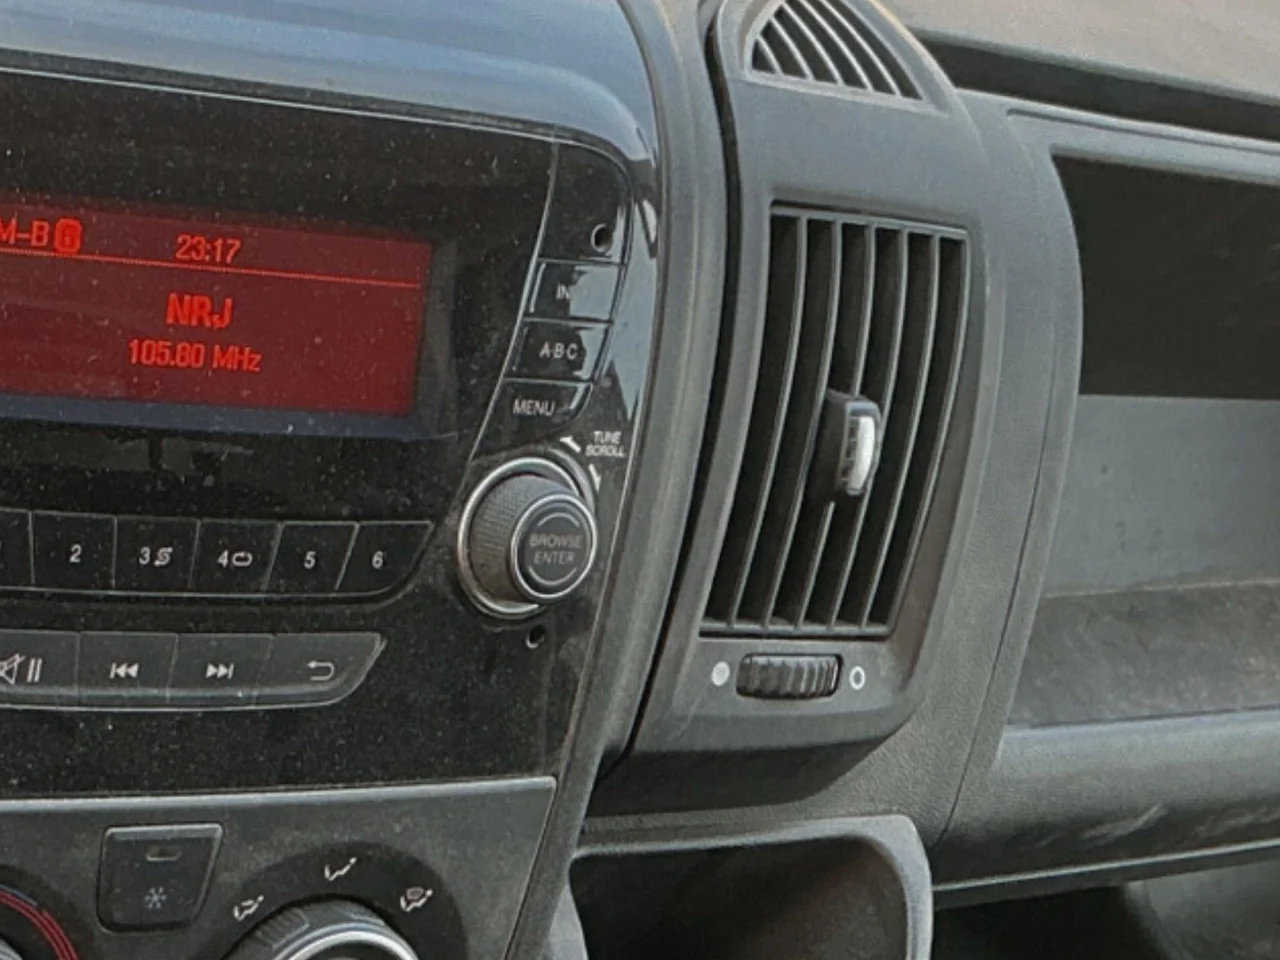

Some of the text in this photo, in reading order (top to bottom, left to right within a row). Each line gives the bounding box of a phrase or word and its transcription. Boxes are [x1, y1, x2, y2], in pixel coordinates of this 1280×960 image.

[176, 234, 242, 264] 23:17
[166, 292, 233, 328] NRJ
[127, 339, 262, 371] 105.80 MHz
[512, 398, 556, 416] MENU
[528, 532, 583, 549] BROWSE
[69, 544, 82, 564] 2
[139, 547, 151, 566] 3
[218, 550, 229, 568] 4
[304, 551, 316, 569] 5
[372, 551, 384, 569] 6
[533, 550, 576, 565] ENTER
